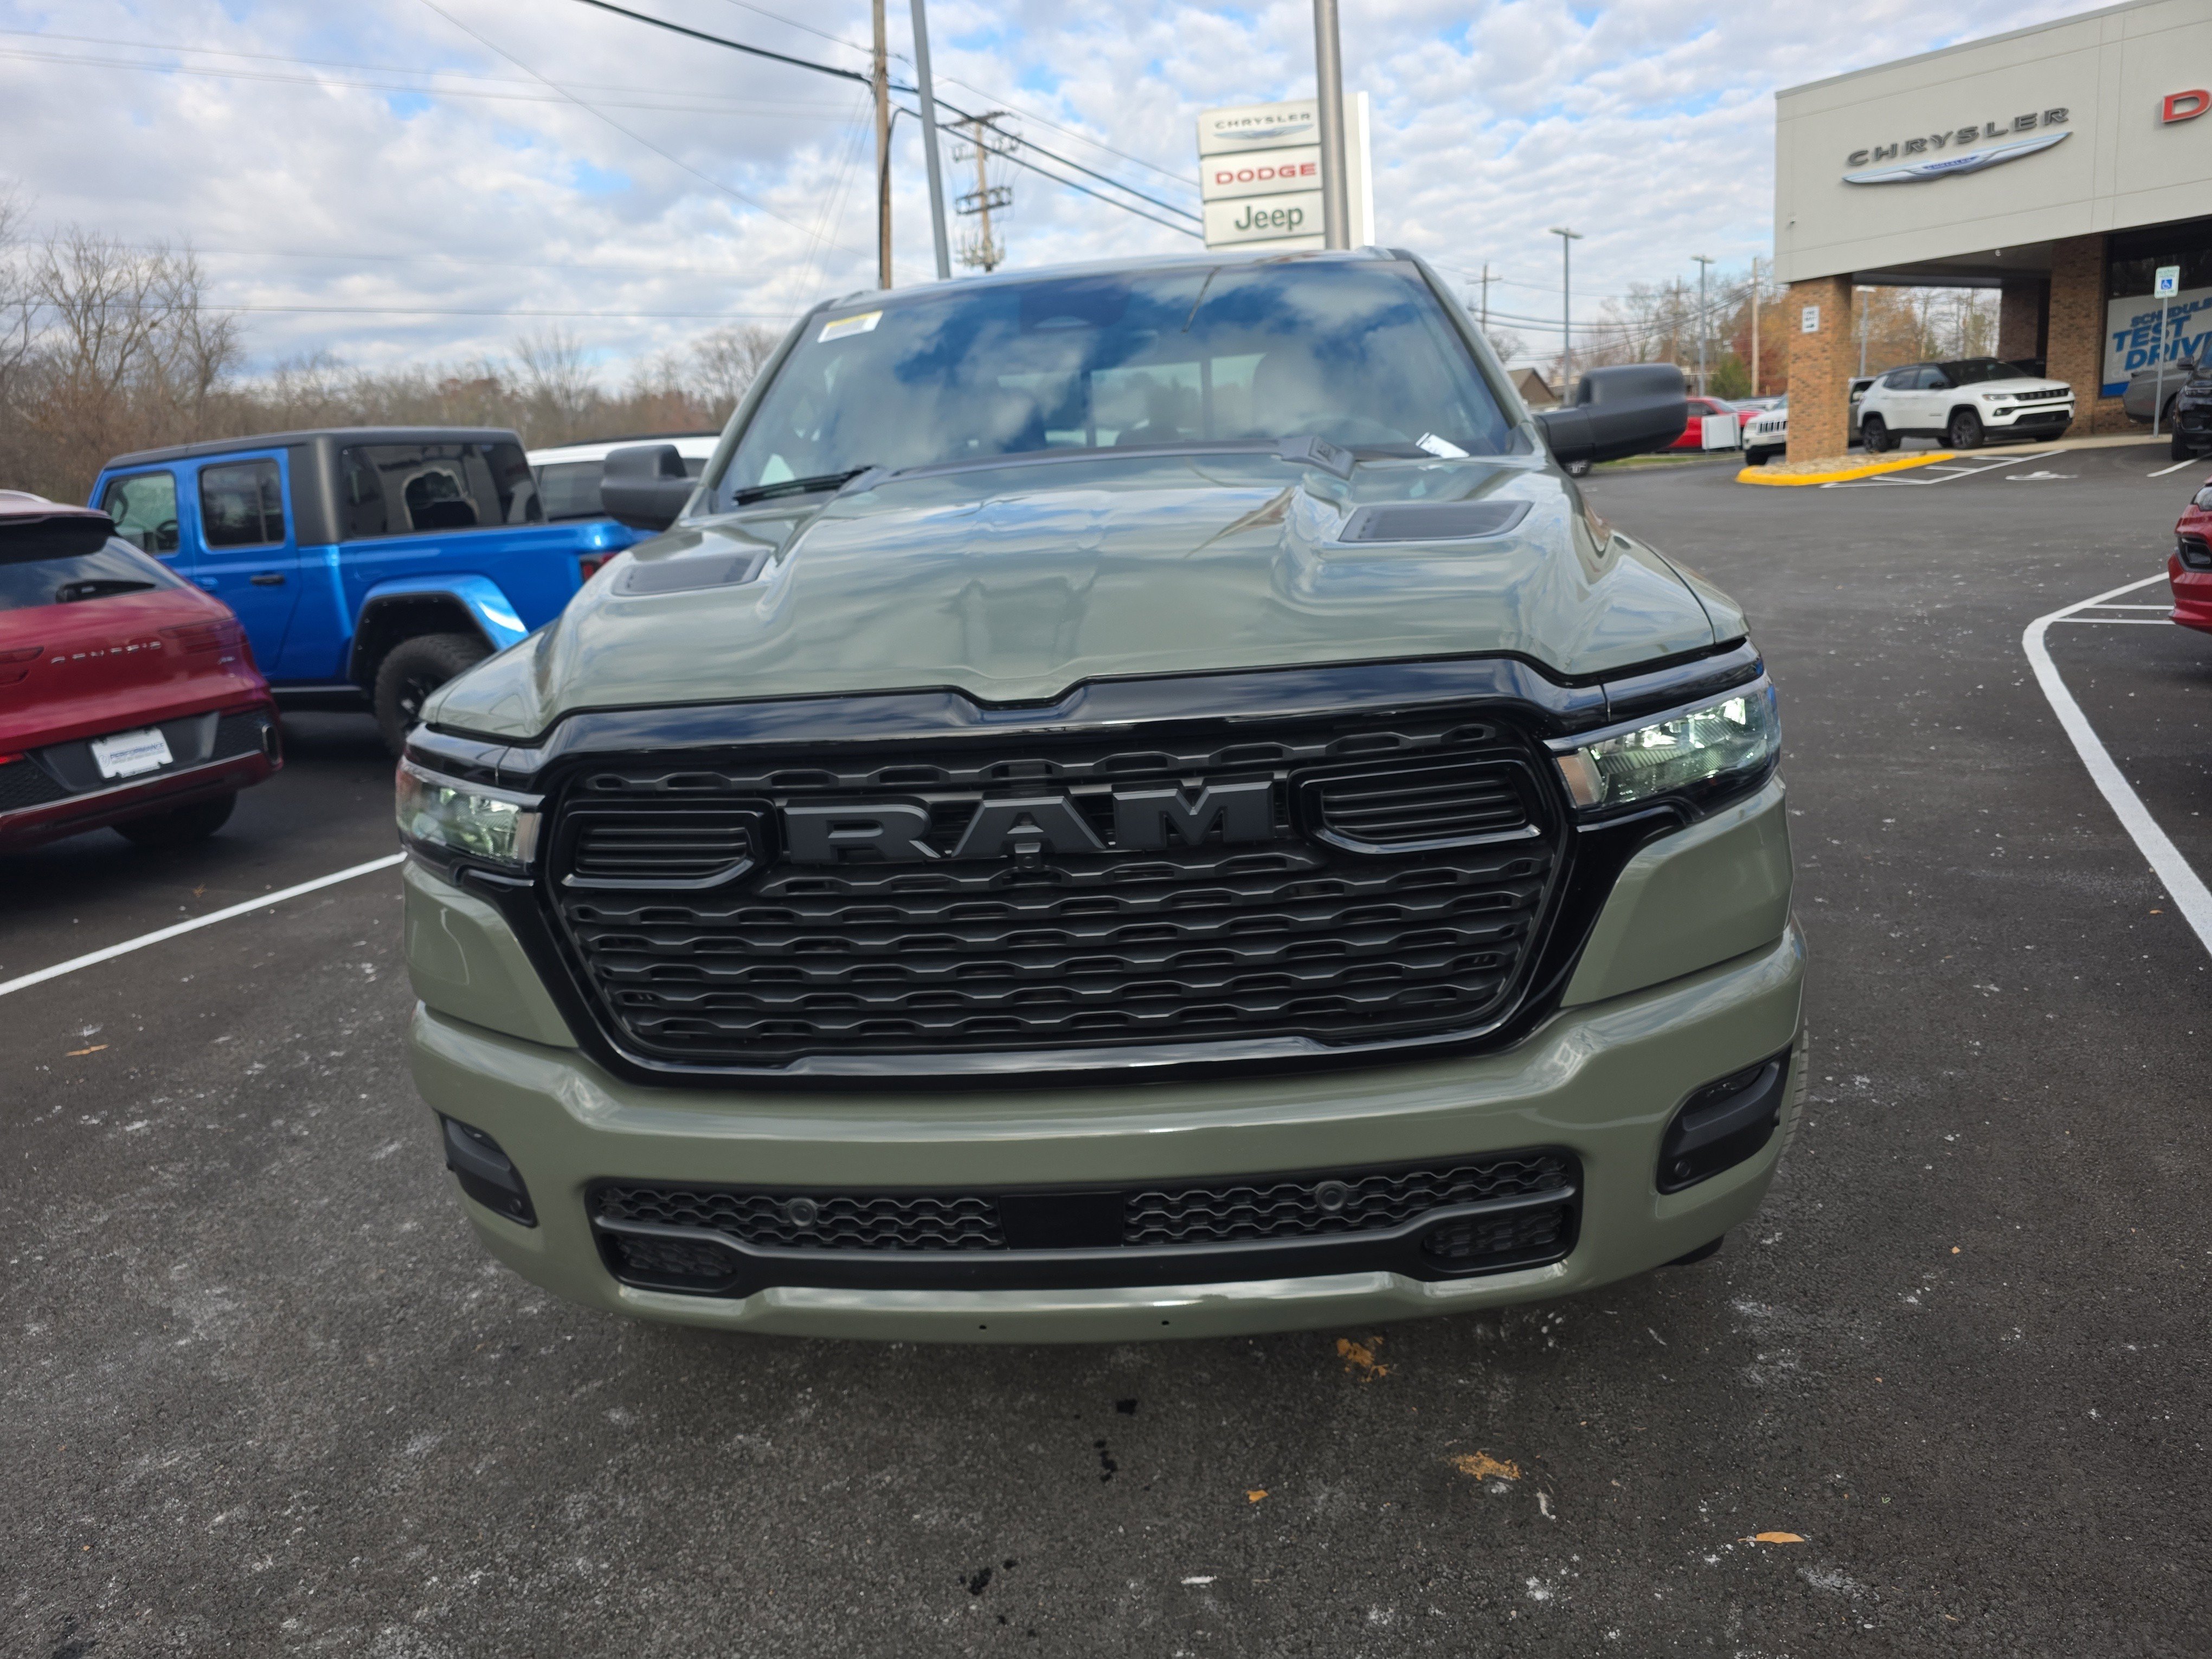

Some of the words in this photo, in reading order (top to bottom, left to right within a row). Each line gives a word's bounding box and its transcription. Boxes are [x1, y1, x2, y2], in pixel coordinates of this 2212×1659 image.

[1214, 113, 1311, 130] CHRYSLER
[1847, 107, 2070, 166] CHRYSLER
[1216, 163, 1316, 185] DODGE
[1235, 205, 1303, 230] Jeep
[2113, 314, 2191, 352] TEST
[784, 774, 1275, 866] RAM
